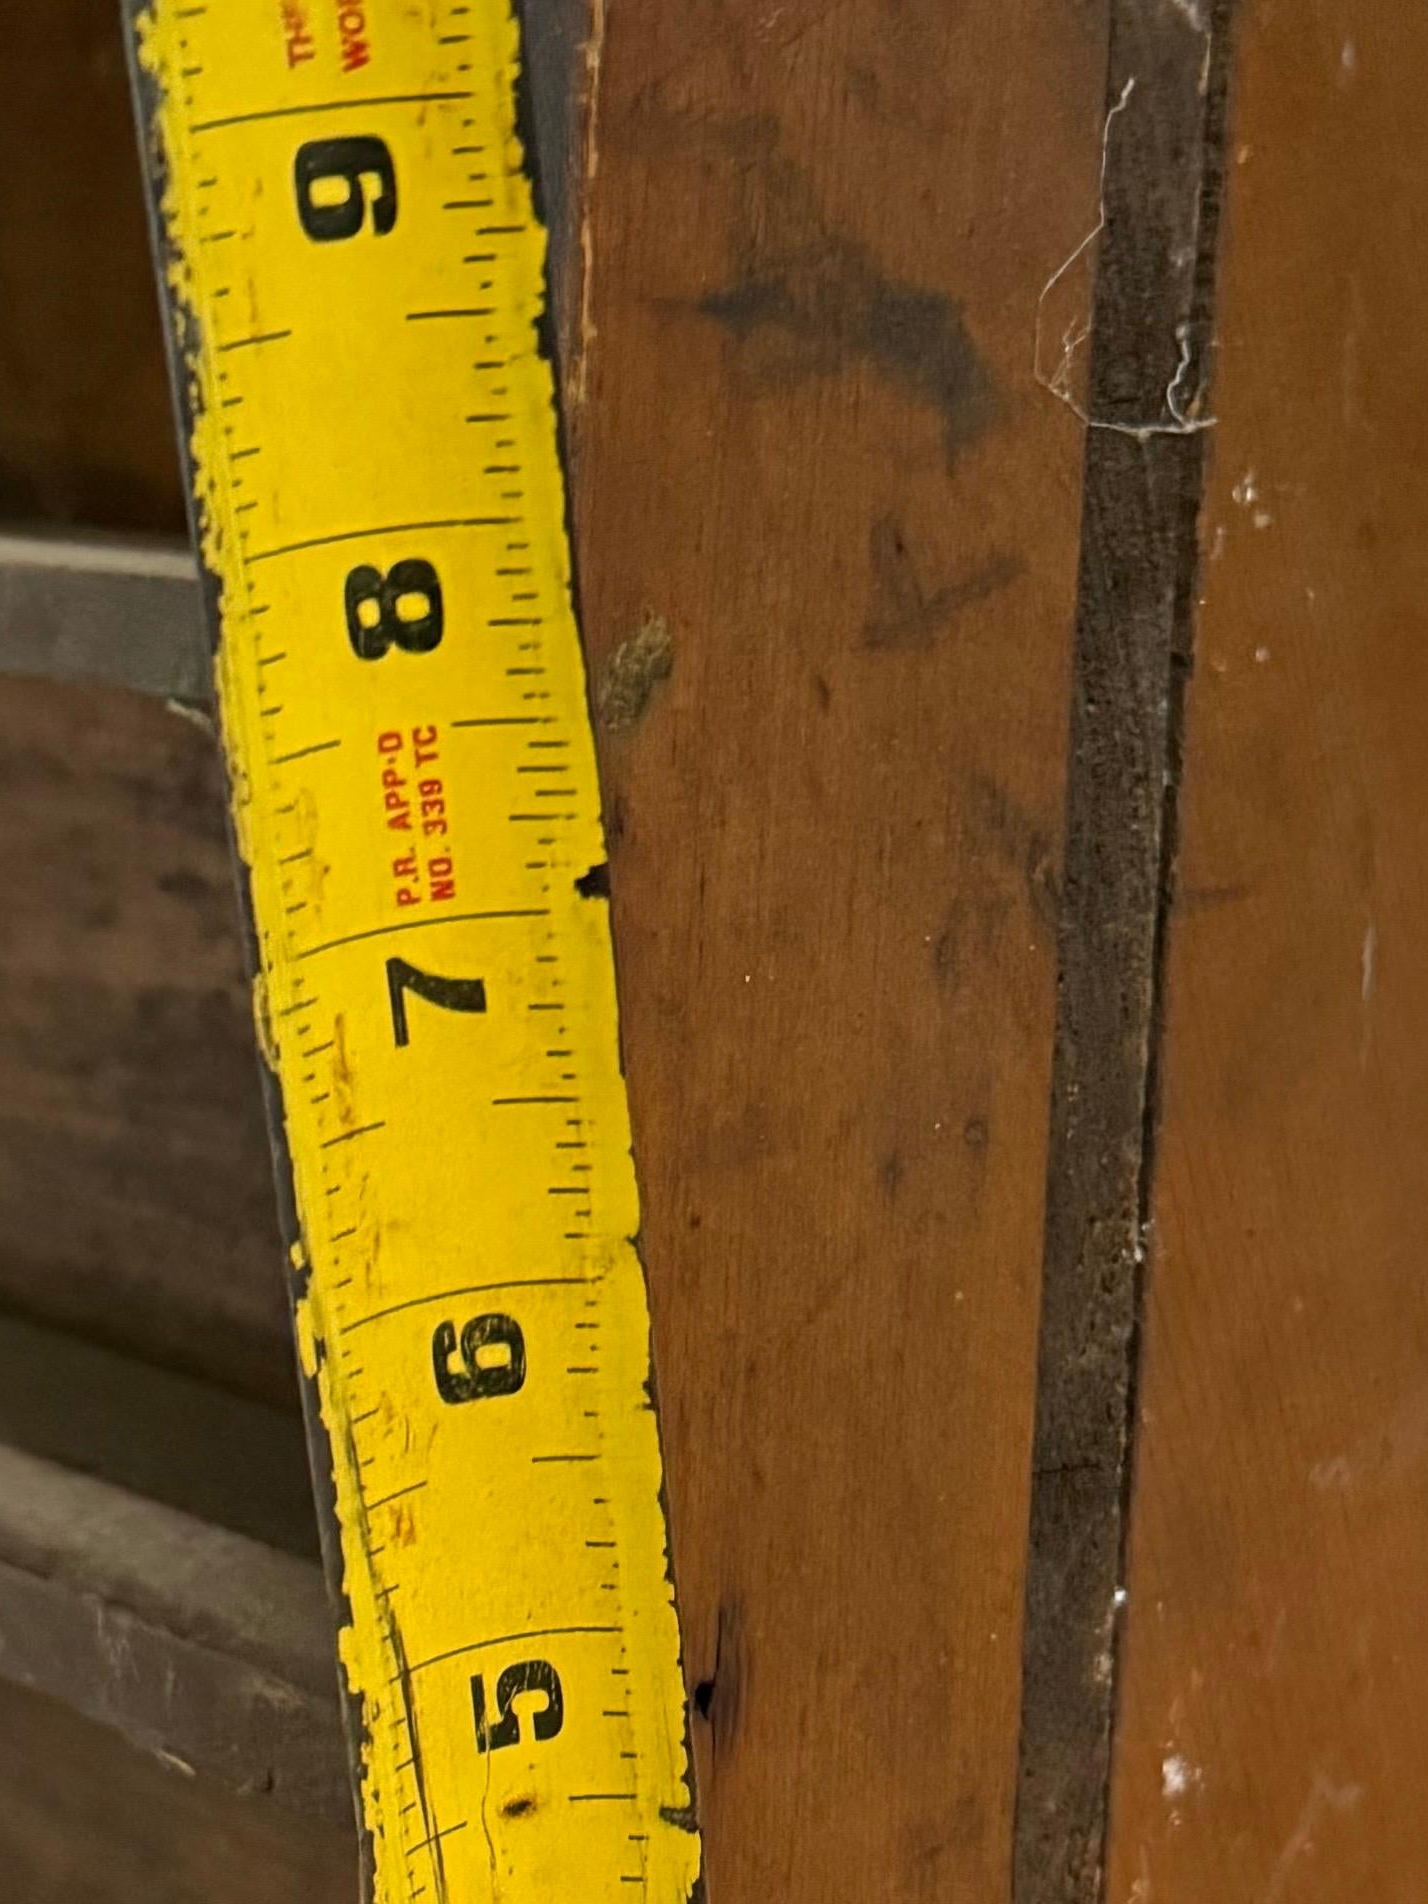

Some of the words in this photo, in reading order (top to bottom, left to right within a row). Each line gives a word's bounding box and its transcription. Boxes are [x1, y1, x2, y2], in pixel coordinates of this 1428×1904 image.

[293, 133, 398, 244] 9
[344, 557, 444, 662] 8
[411, 725, 440, 769] TC
[418, 779, 448, 837] 339
[391, 847, 422, 907] P.R.
[427, 845, 456, 902] NO.
[385, 957, 488, 1049] 7
[432, 1312, 526, 1406] 6
[470, 1659, 565, 1755] 5
